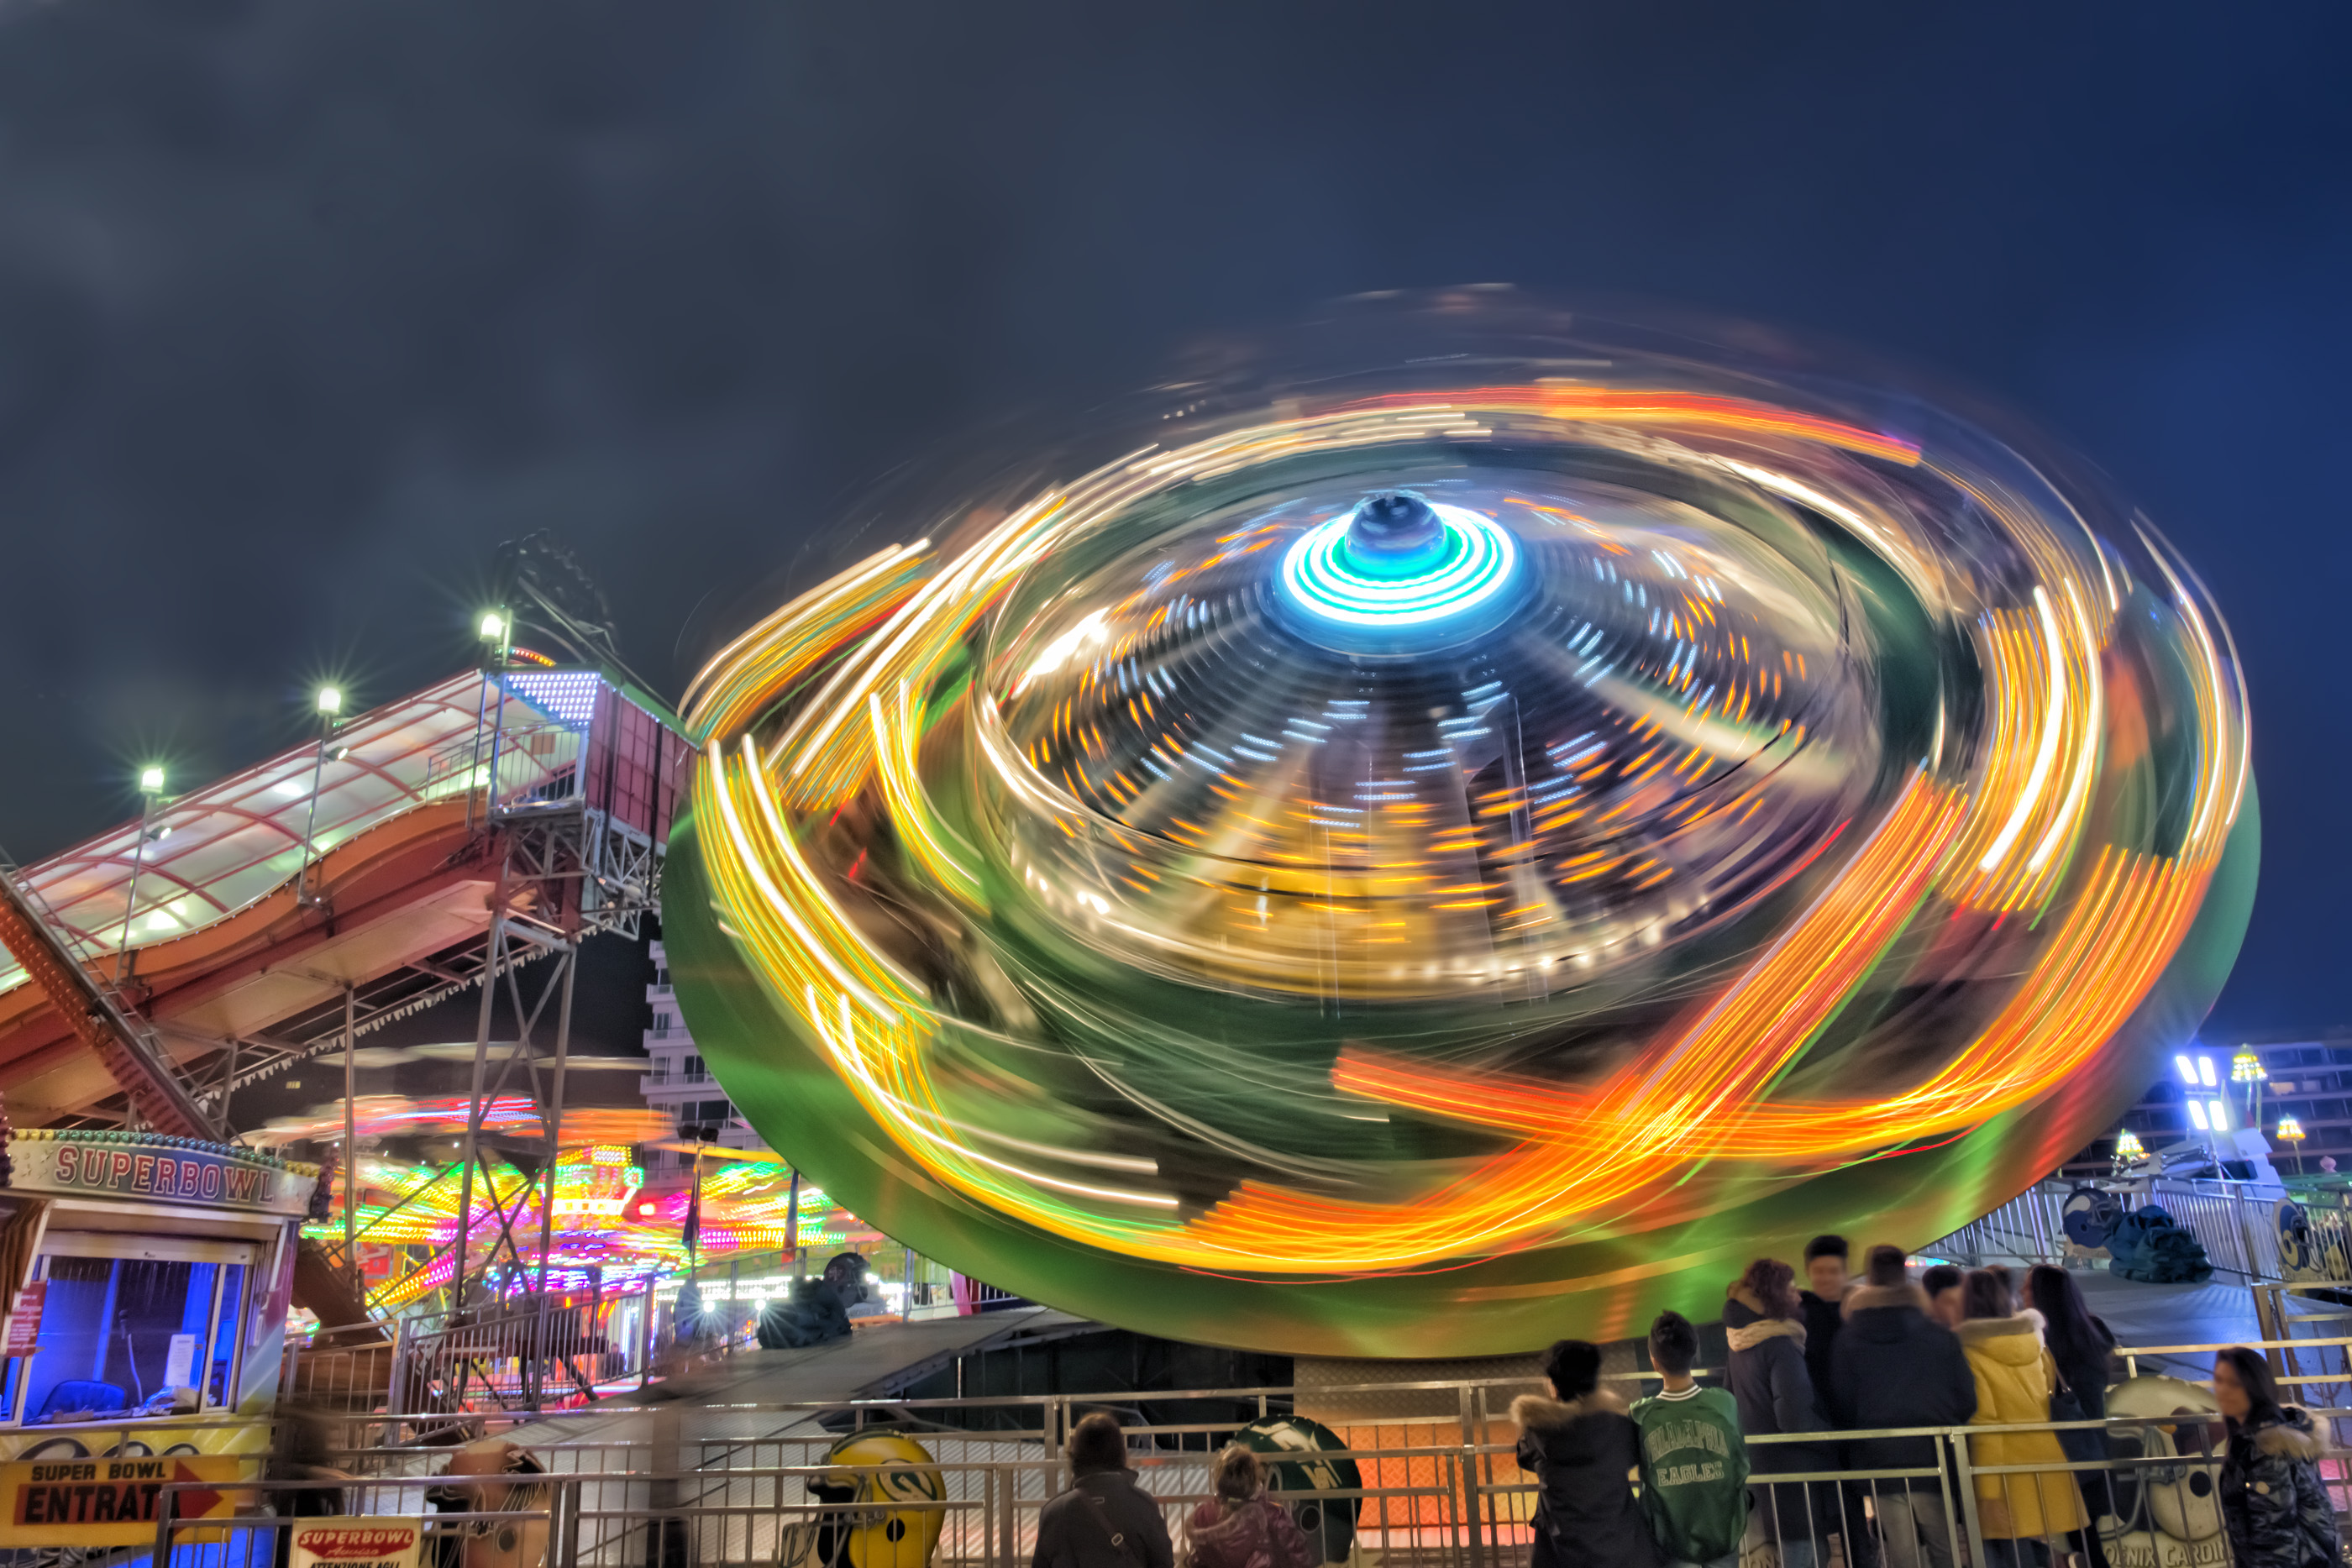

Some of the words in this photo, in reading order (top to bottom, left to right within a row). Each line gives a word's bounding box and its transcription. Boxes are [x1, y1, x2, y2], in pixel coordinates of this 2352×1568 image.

[55, 1145, 276, 1204] SUPERBOWL
[1645, 1419, 1730, 1464] HILADELPHIA
[31, 1464, 97, 1481] SUPER
[108, 1461, 166, 1480] BOWL
[1656, 1460, 1725, 1487] EAGLES
[300, 1530, 413, 1544] SUPERBOWL
